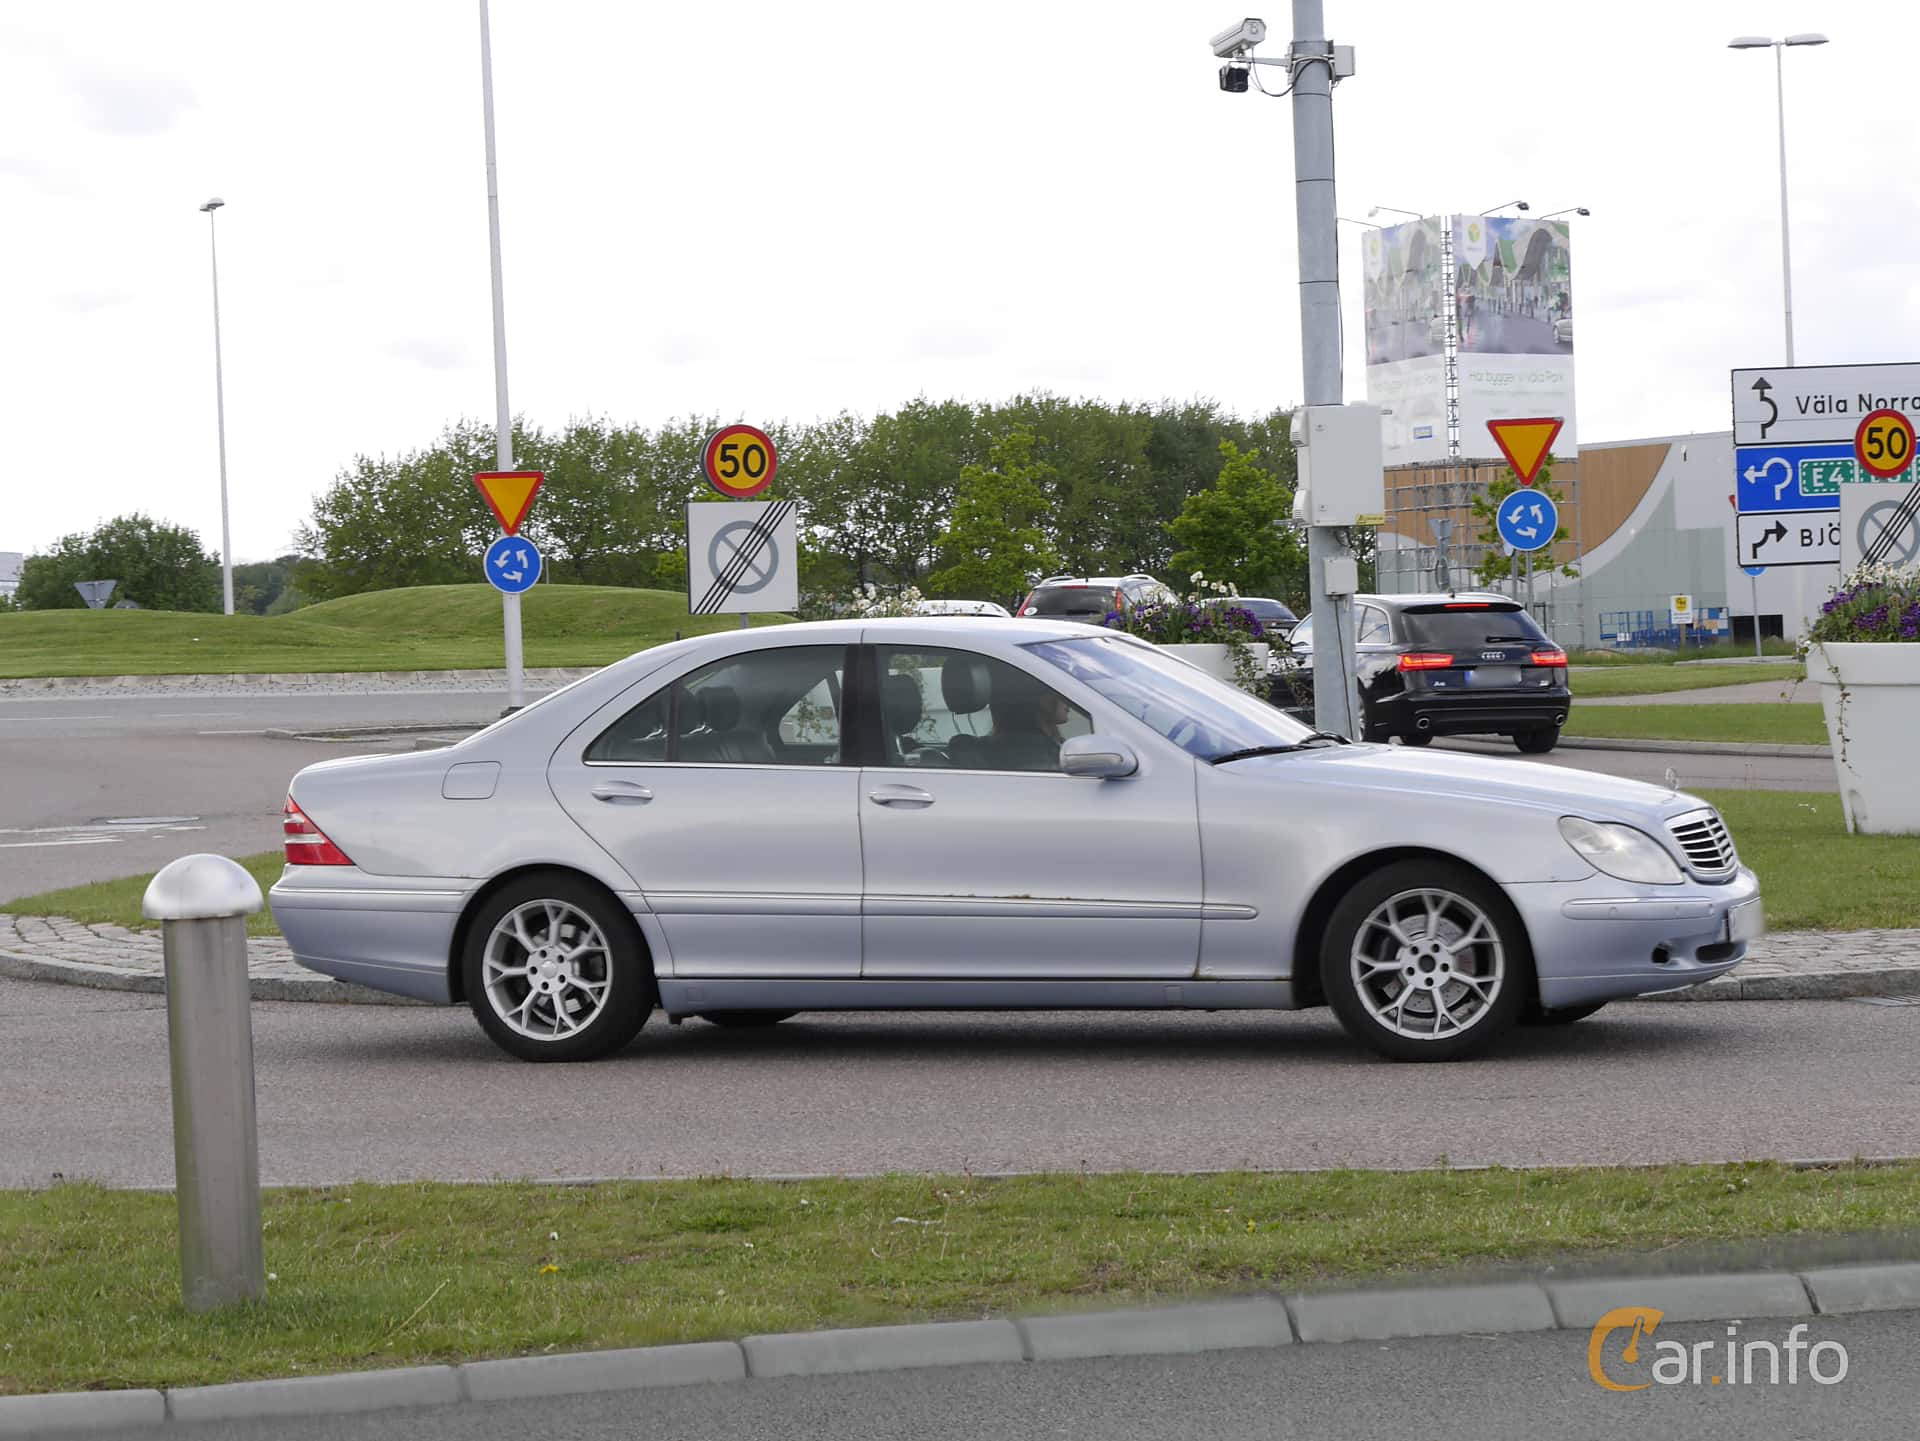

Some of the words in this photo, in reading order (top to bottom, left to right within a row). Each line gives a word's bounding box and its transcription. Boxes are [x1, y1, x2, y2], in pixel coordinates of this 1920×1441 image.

[1795, 395, 1848, 414] Väla
[1867, 427, 1908, 460] 50
[720, 444, 766, 478] 50
